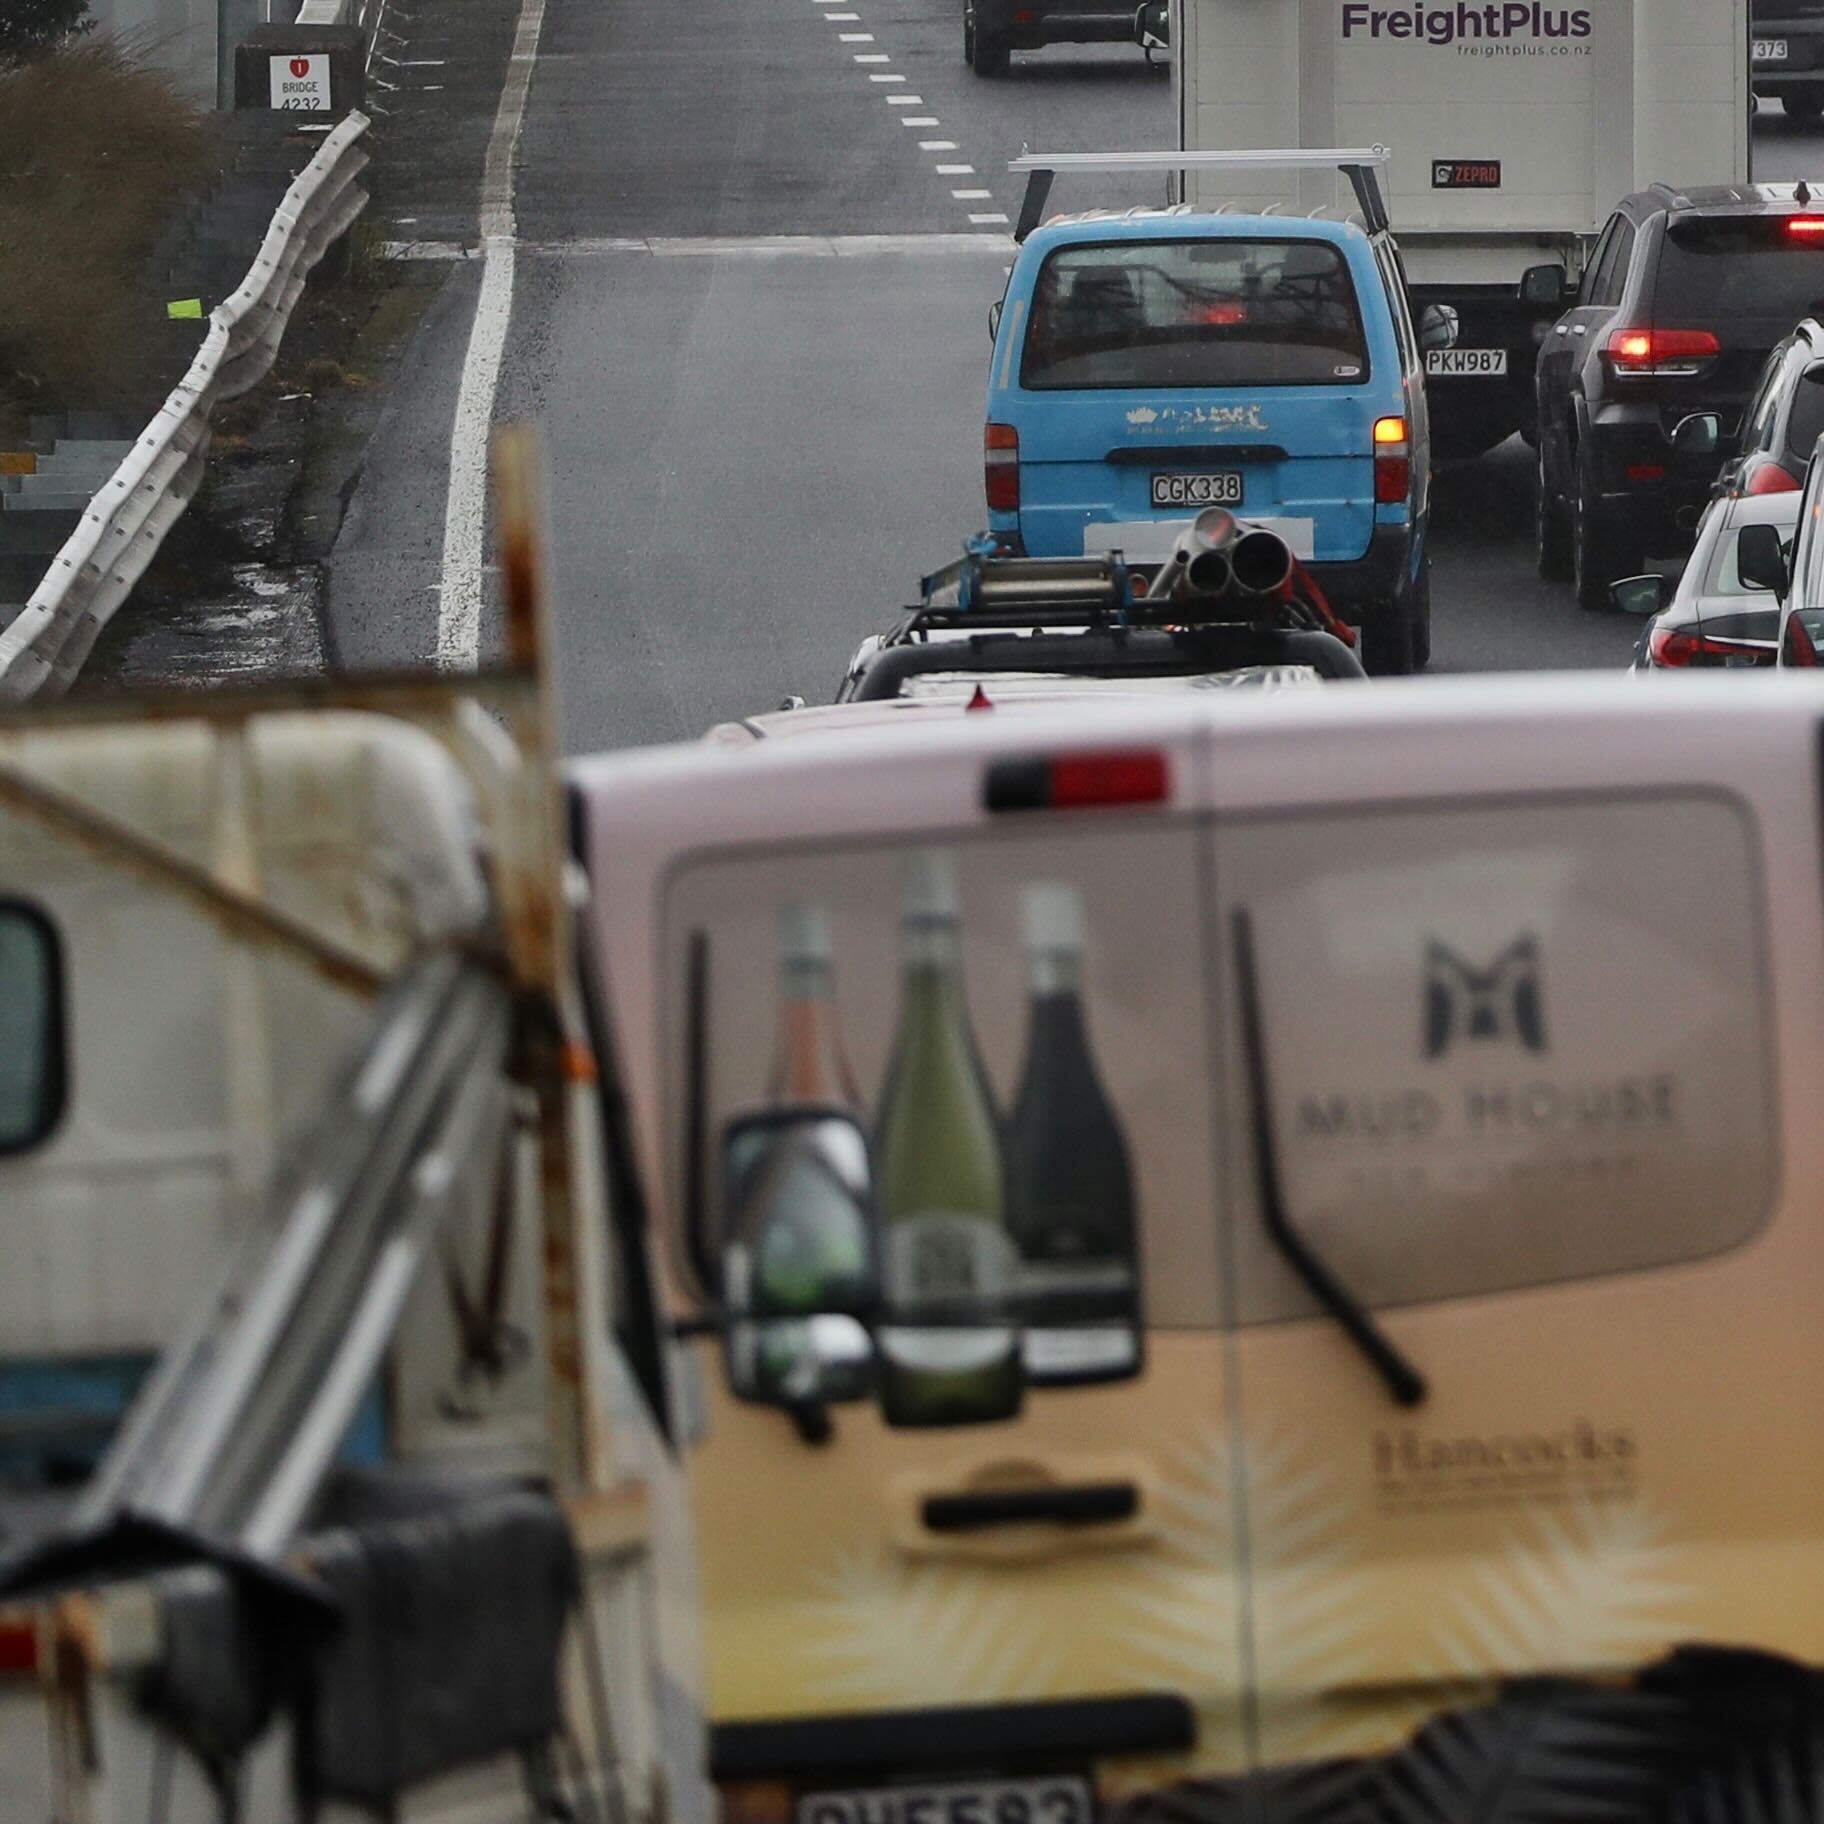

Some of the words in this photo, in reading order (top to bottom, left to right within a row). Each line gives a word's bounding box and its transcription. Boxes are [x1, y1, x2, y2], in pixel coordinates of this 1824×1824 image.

[1343, 2, 1592, 45] FreightPlus
[1457, 44, 1592, 58] freightplus.co.nz
[282, 82, 319, 93] BRIDGE
[1455, 165, 1499, 183] ZEPRO
[1427, 352, 1505, 372] PKW987
[1153, 476, 1242, 503] CGK338
[1298, 1088, 1442, 1136] MUD
[1463, 1074, 1676, 1128] HOUSE
[1375, 1421, 1637, 1476] Hancocks
